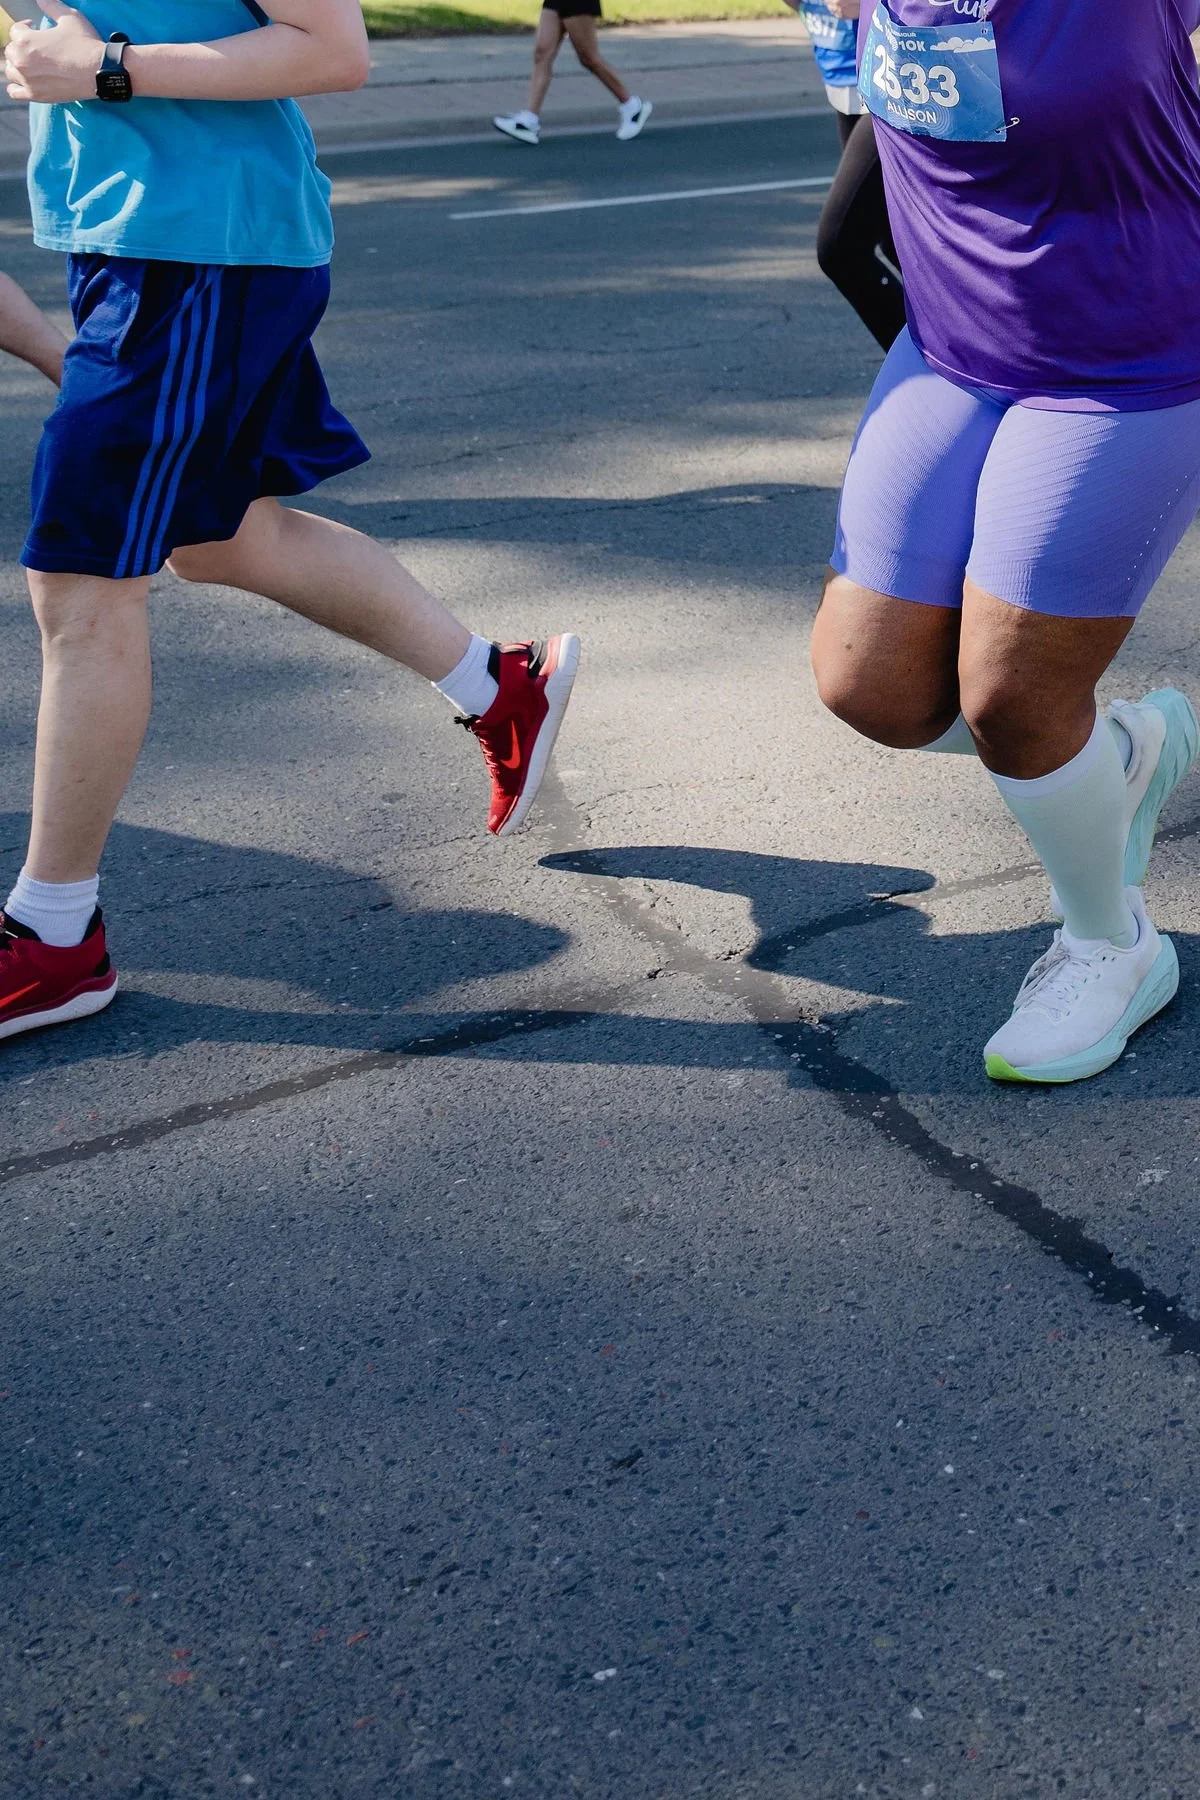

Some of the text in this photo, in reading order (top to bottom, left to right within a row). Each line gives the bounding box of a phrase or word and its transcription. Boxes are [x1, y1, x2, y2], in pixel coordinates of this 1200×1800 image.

[899, 40, 926, 52] 10K
[873, 45, 960, 108] 2533
[887, 100, 938, 124] ALLISON
